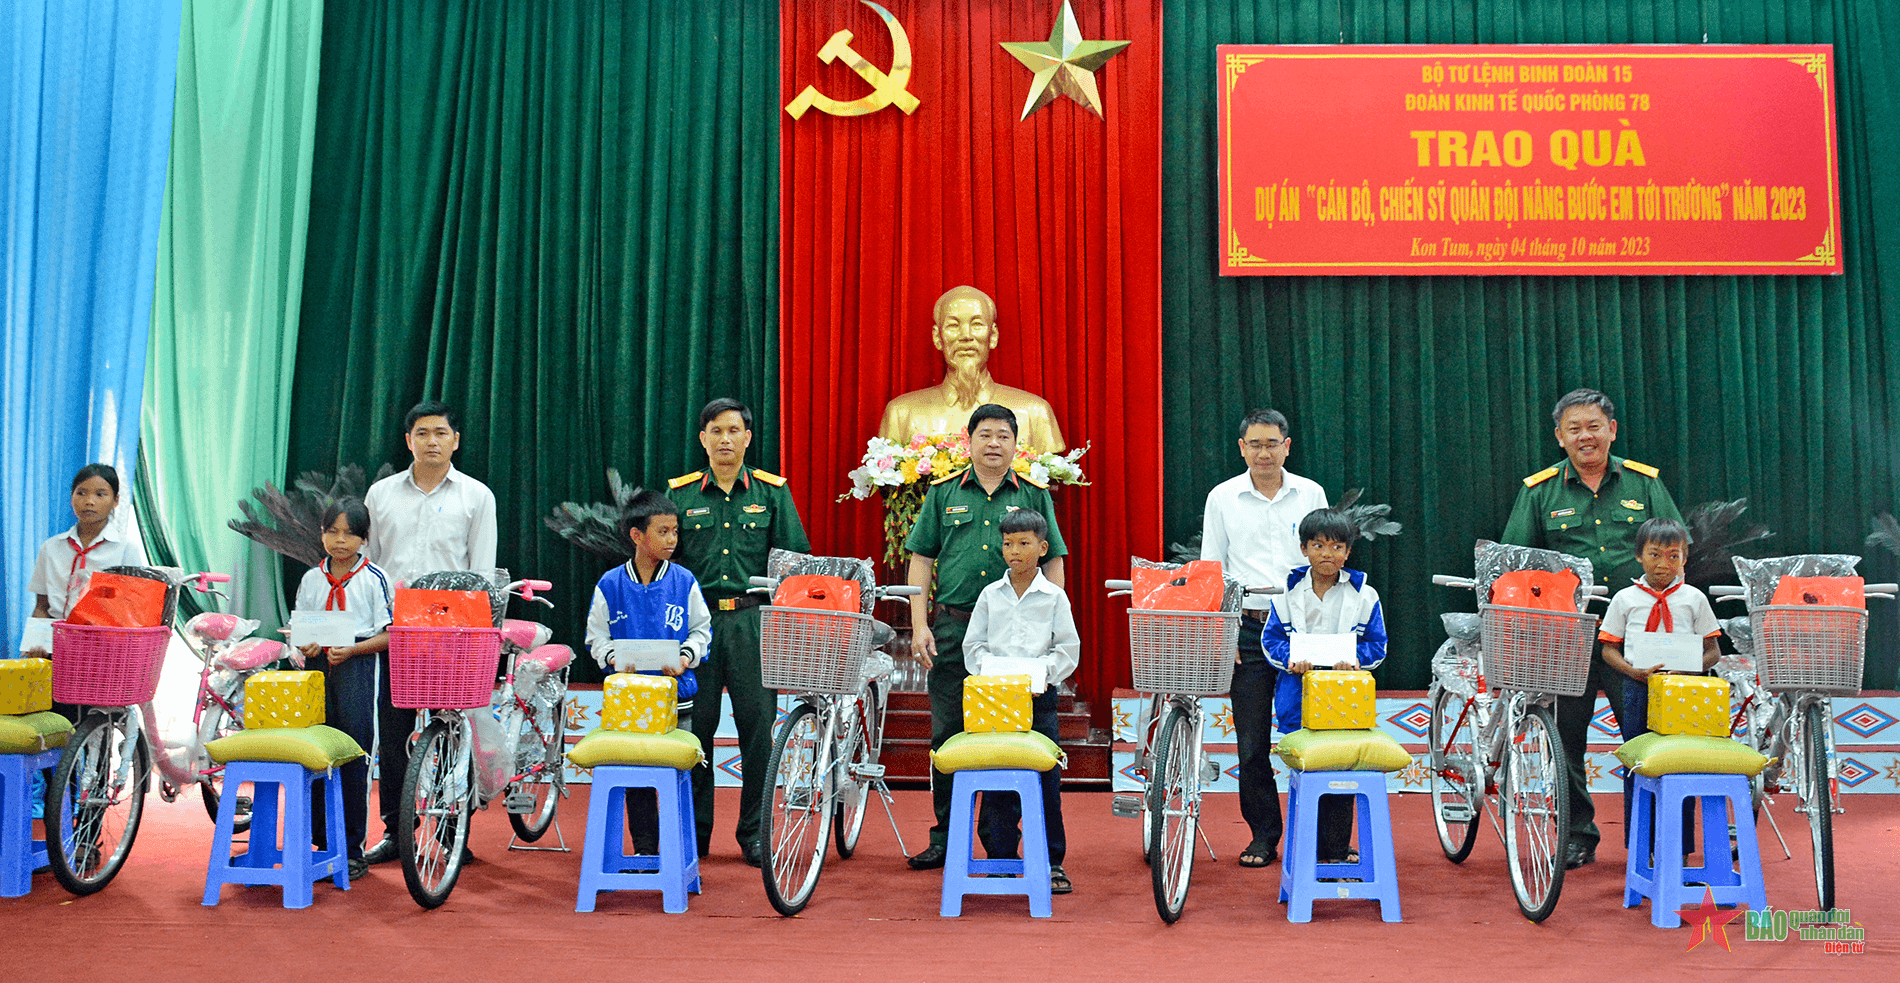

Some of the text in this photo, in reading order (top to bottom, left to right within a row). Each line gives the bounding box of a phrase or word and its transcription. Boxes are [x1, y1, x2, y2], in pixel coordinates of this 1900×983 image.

[1422, 61, 1632, 88] BỘ TƯ LỆNH BINH ĐOÀN 15
[1405, 88, 1650, 113] ĐOÀN KINH TẾ QUỐC PHÒNG 78
[1410, 118, 1646, 170] TRAO QUÀ
[1255, 183, 1277, 229] DỰ
[1278, 178, 1300, 221] ÁN
[1351, 179, 1376, 227] BỘ,
[1380, 177, 1424, 221] CHIẾN
[1428, 179, 1446, 221] SỸ
[1450, 179, 1490, 225] QUÂN
[1494, 179, 1519, 229] ĐỘI
[1523, 178, 1564, 221] NÂNG
[1567, 177, 1607, 221] BƯỚC
[1610, 186, 1633, 221] EM
[1637, 178, 1661, 221] TỚI
[1732, 179, 1768, 221] NĂM
[1770, 186, 1806, 221] 2023
[1410, 237, 1651, 262] Kon Tum, ngày 04 tháng 10 năm 2023
